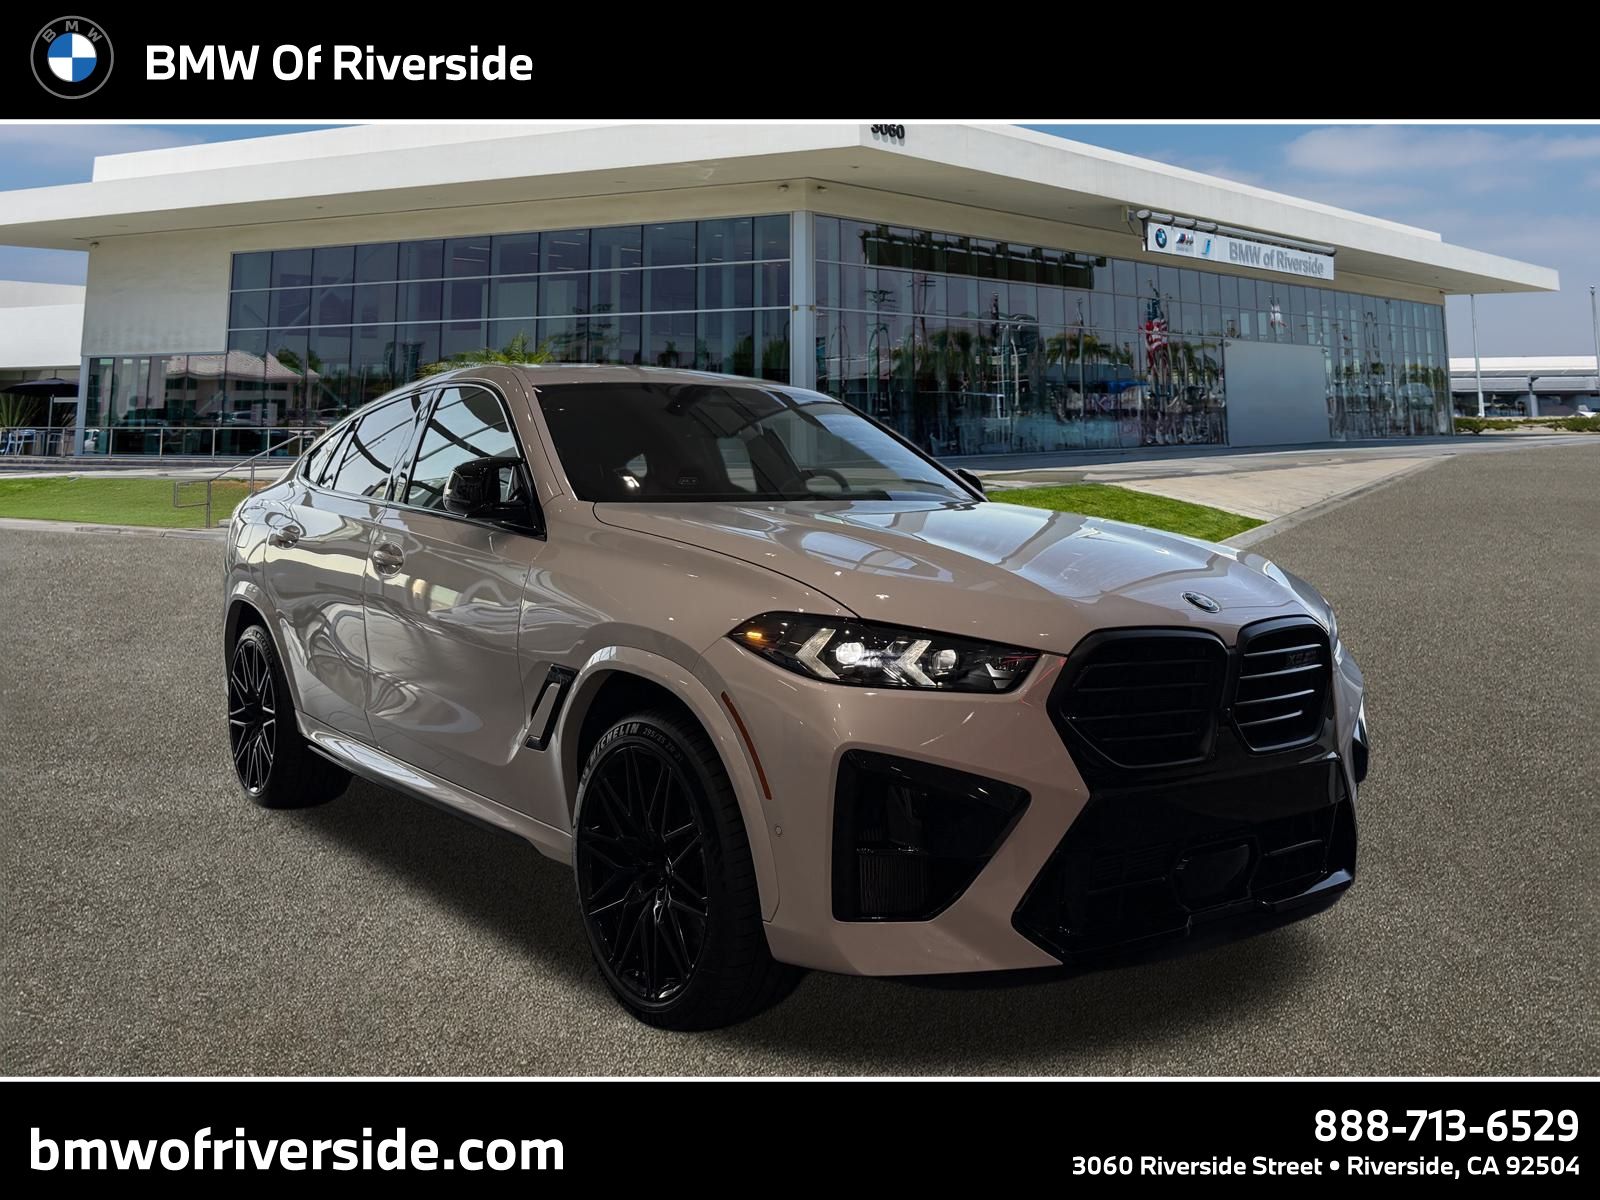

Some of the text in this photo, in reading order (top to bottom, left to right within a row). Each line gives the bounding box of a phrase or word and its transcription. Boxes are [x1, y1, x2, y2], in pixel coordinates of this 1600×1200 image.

[1229, 242, 1260, 265] BMW
[1263, 251, 1276, 266] of
[1276, 252, 1324, 275] Riverside
[590, 722, 640, 766] MICHELIN
